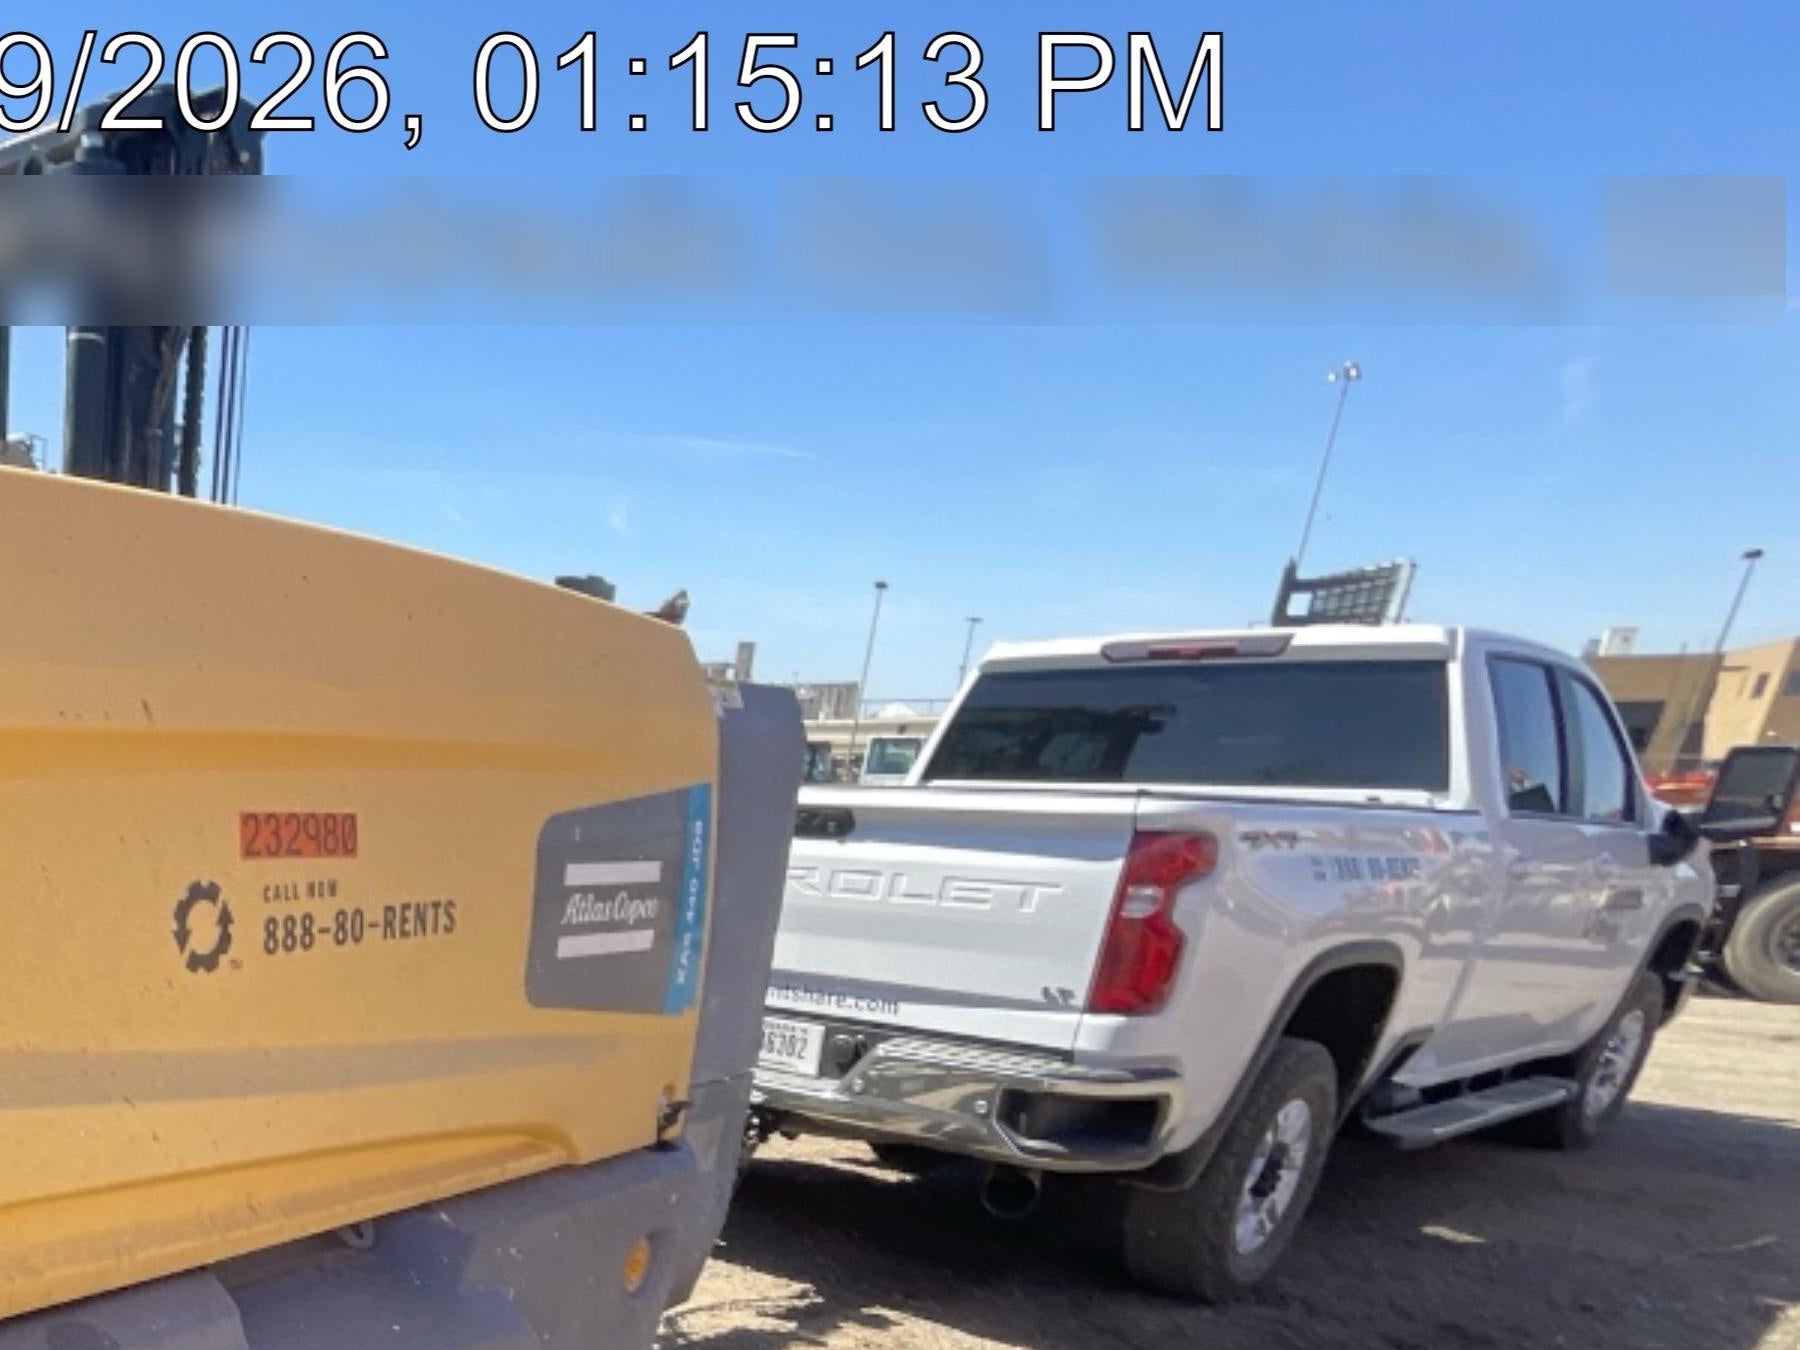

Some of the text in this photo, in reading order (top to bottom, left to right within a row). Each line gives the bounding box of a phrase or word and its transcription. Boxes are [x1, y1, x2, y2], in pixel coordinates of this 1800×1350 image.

[242, 813, 357, 857] 232980
[263, 880, 337, 903] CALL NOW
[561, 893, 612, 925] Atlas
[264, 900, 456, 955] 888-80-RENTS
